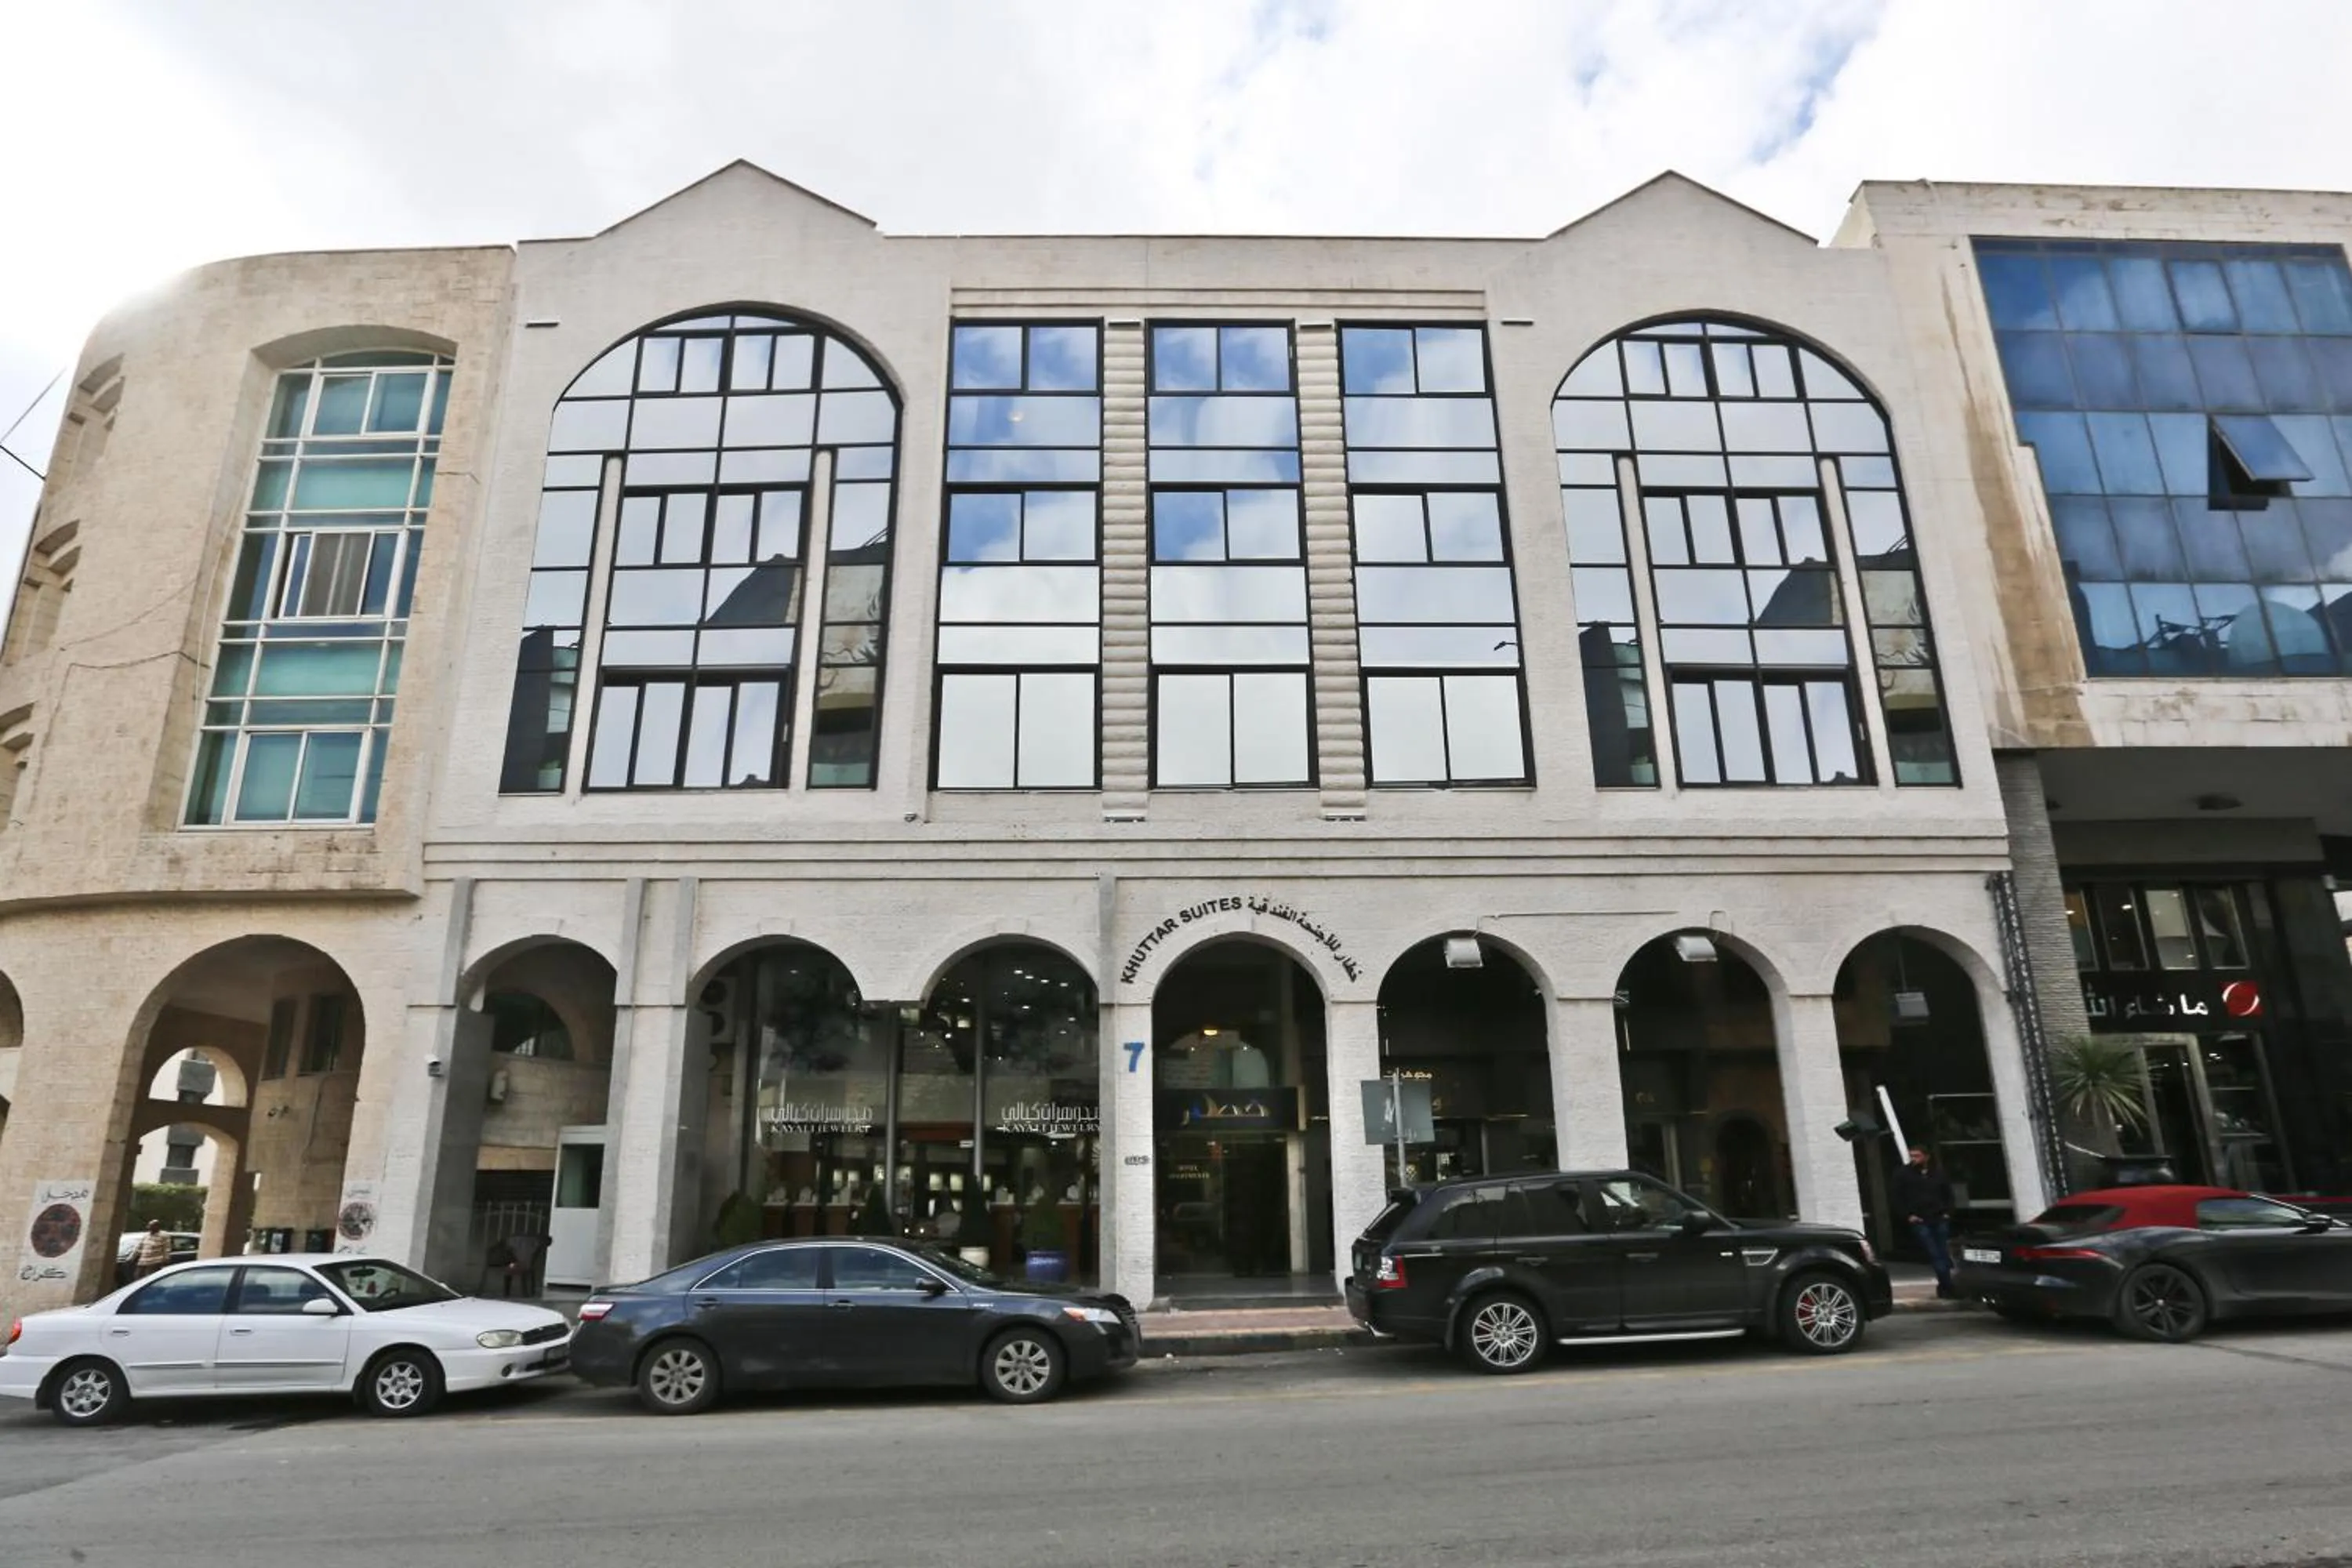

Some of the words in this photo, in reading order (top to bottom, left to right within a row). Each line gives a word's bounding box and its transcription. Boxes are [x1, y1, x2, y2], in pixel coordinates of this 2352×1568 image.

[1247, 896, 1298, 921] الفندقية
[1120, 918, 1180, 984] KHUTTAR
[1179, 896, 1243, 923] SUITES
[1334, 953, 1363, 982] خطار
[2179, 993, 2209, 1016] ما
[1123, 1041, 1145, 1073] 7
